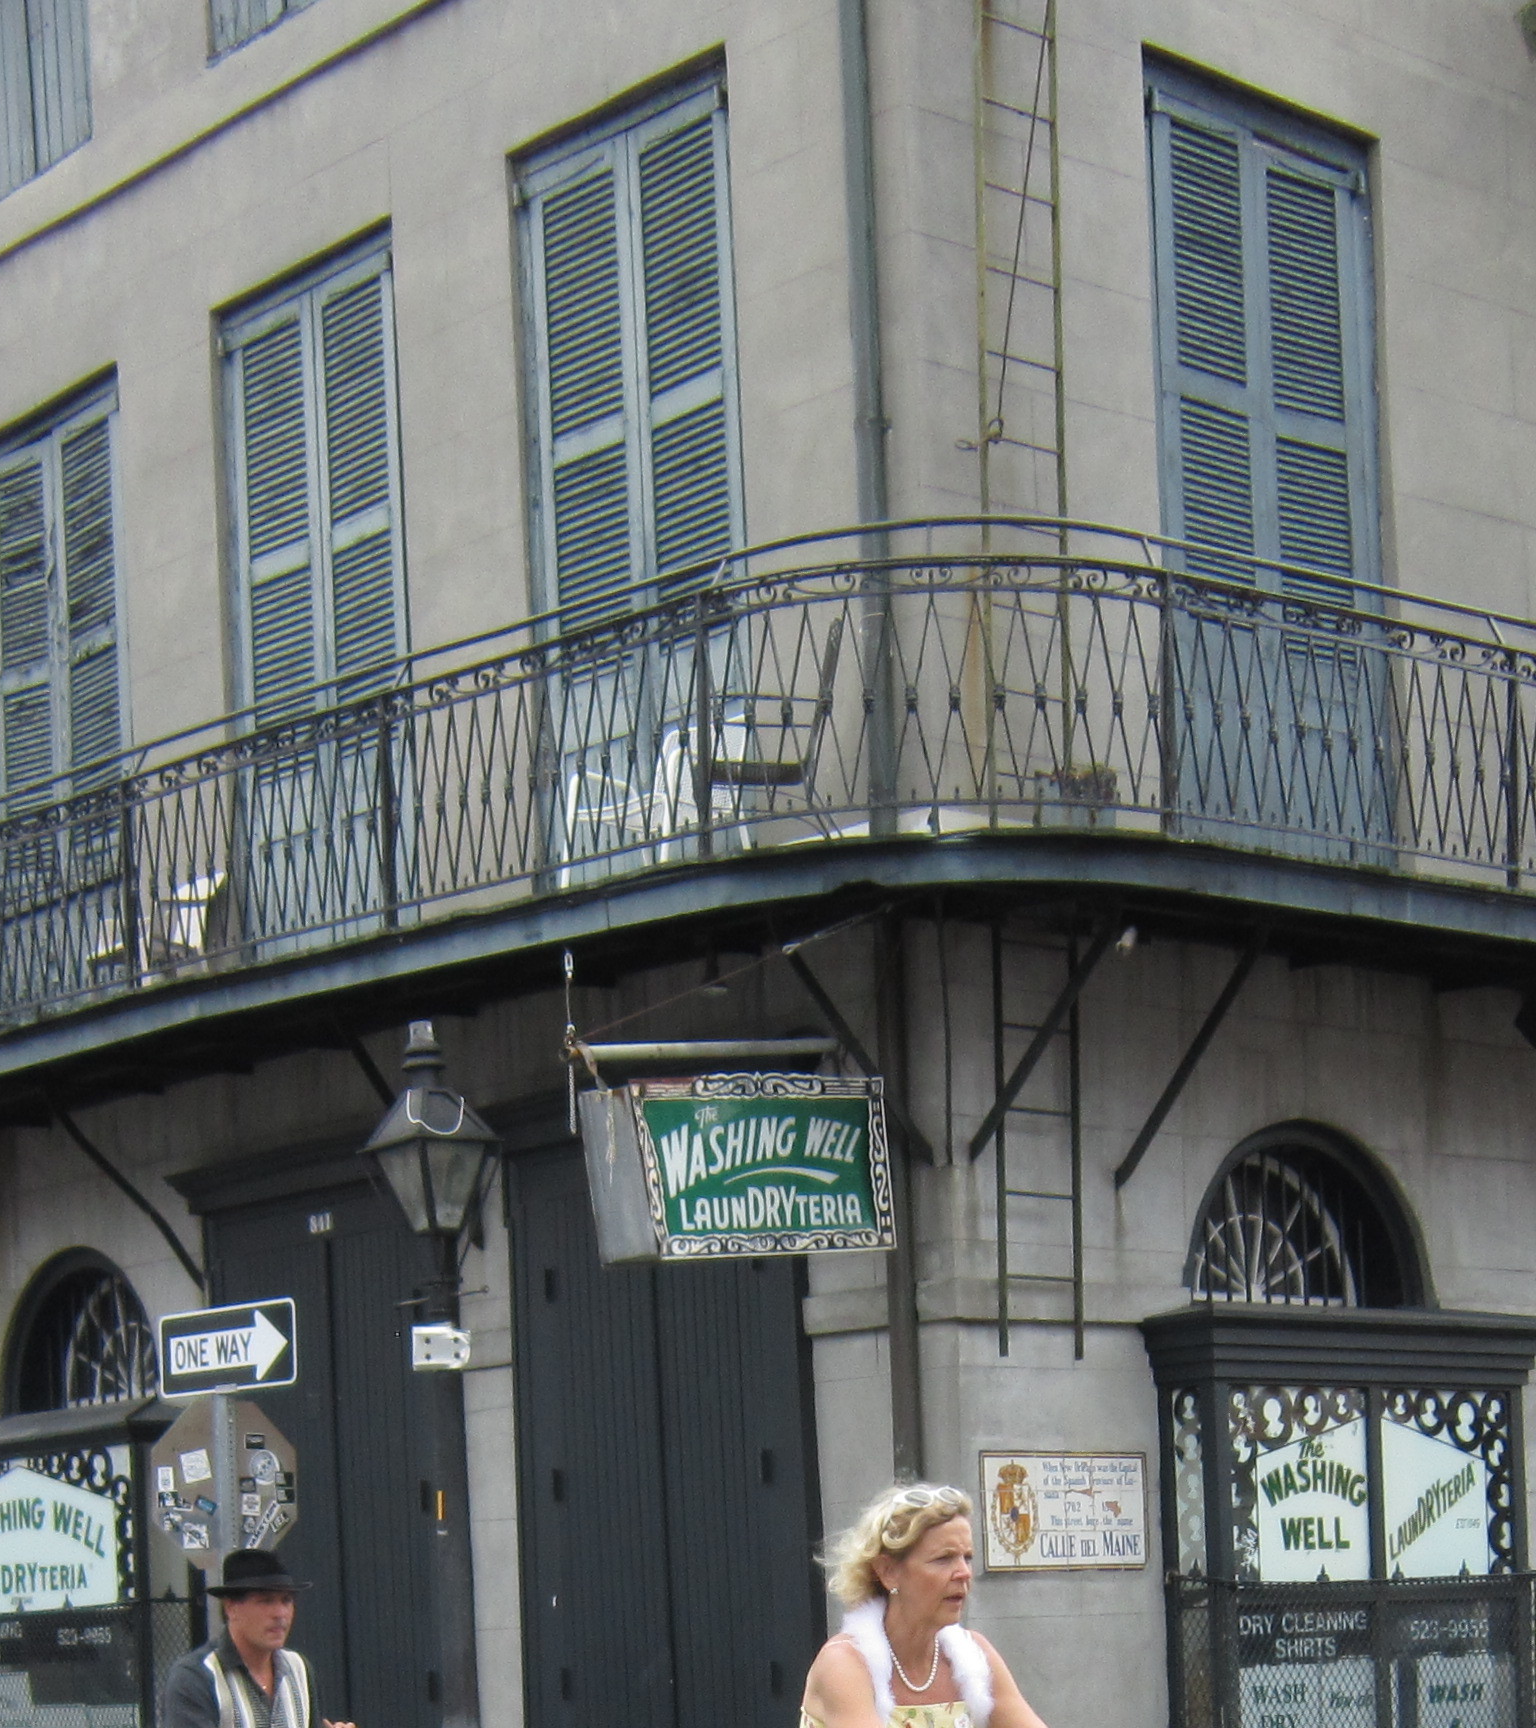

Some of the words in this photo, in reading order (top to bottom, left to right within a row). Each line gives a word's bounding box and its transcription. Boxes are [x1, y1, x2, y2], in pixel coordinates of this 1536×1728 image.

[695, 1105, 719, 1129] The
[660, 1115, 797, 1199] WASHING
[804, 1116, 862, 1164] WELL
[679, 1185, 863, 1231] LAUNDRYTERIA
[174, 1337, 210, 1370] ONE
[215, 1331, 252, 1365] WAY
[1298, 1437, 1326, 1460] The
[1052, 1475, 1062, 1486] the
[1260, 1459, 1368, 1508] WASHING
[1388, 1462, 1477, 1561] LAUNDRYTERIA
[52, 1499, 107, 1559] WELL
[1280, 1516, 1351, 1551] WELL
[1040, 1532, 1076, 1559] CALLE
[1080, 1539, 1100, 1558] DEL
[1102, 1530, 1142, 1557] MAINE
[1238, 1613, 1275, 1636] DRY
[1281, 1609, 1368, 1634] CLEANING
[1275, 1636, 1337, 1659] SHIRTS
[1253, 1683, 1308, 1704] WASH
[1428, 1683, 1485, 1704] WASH
